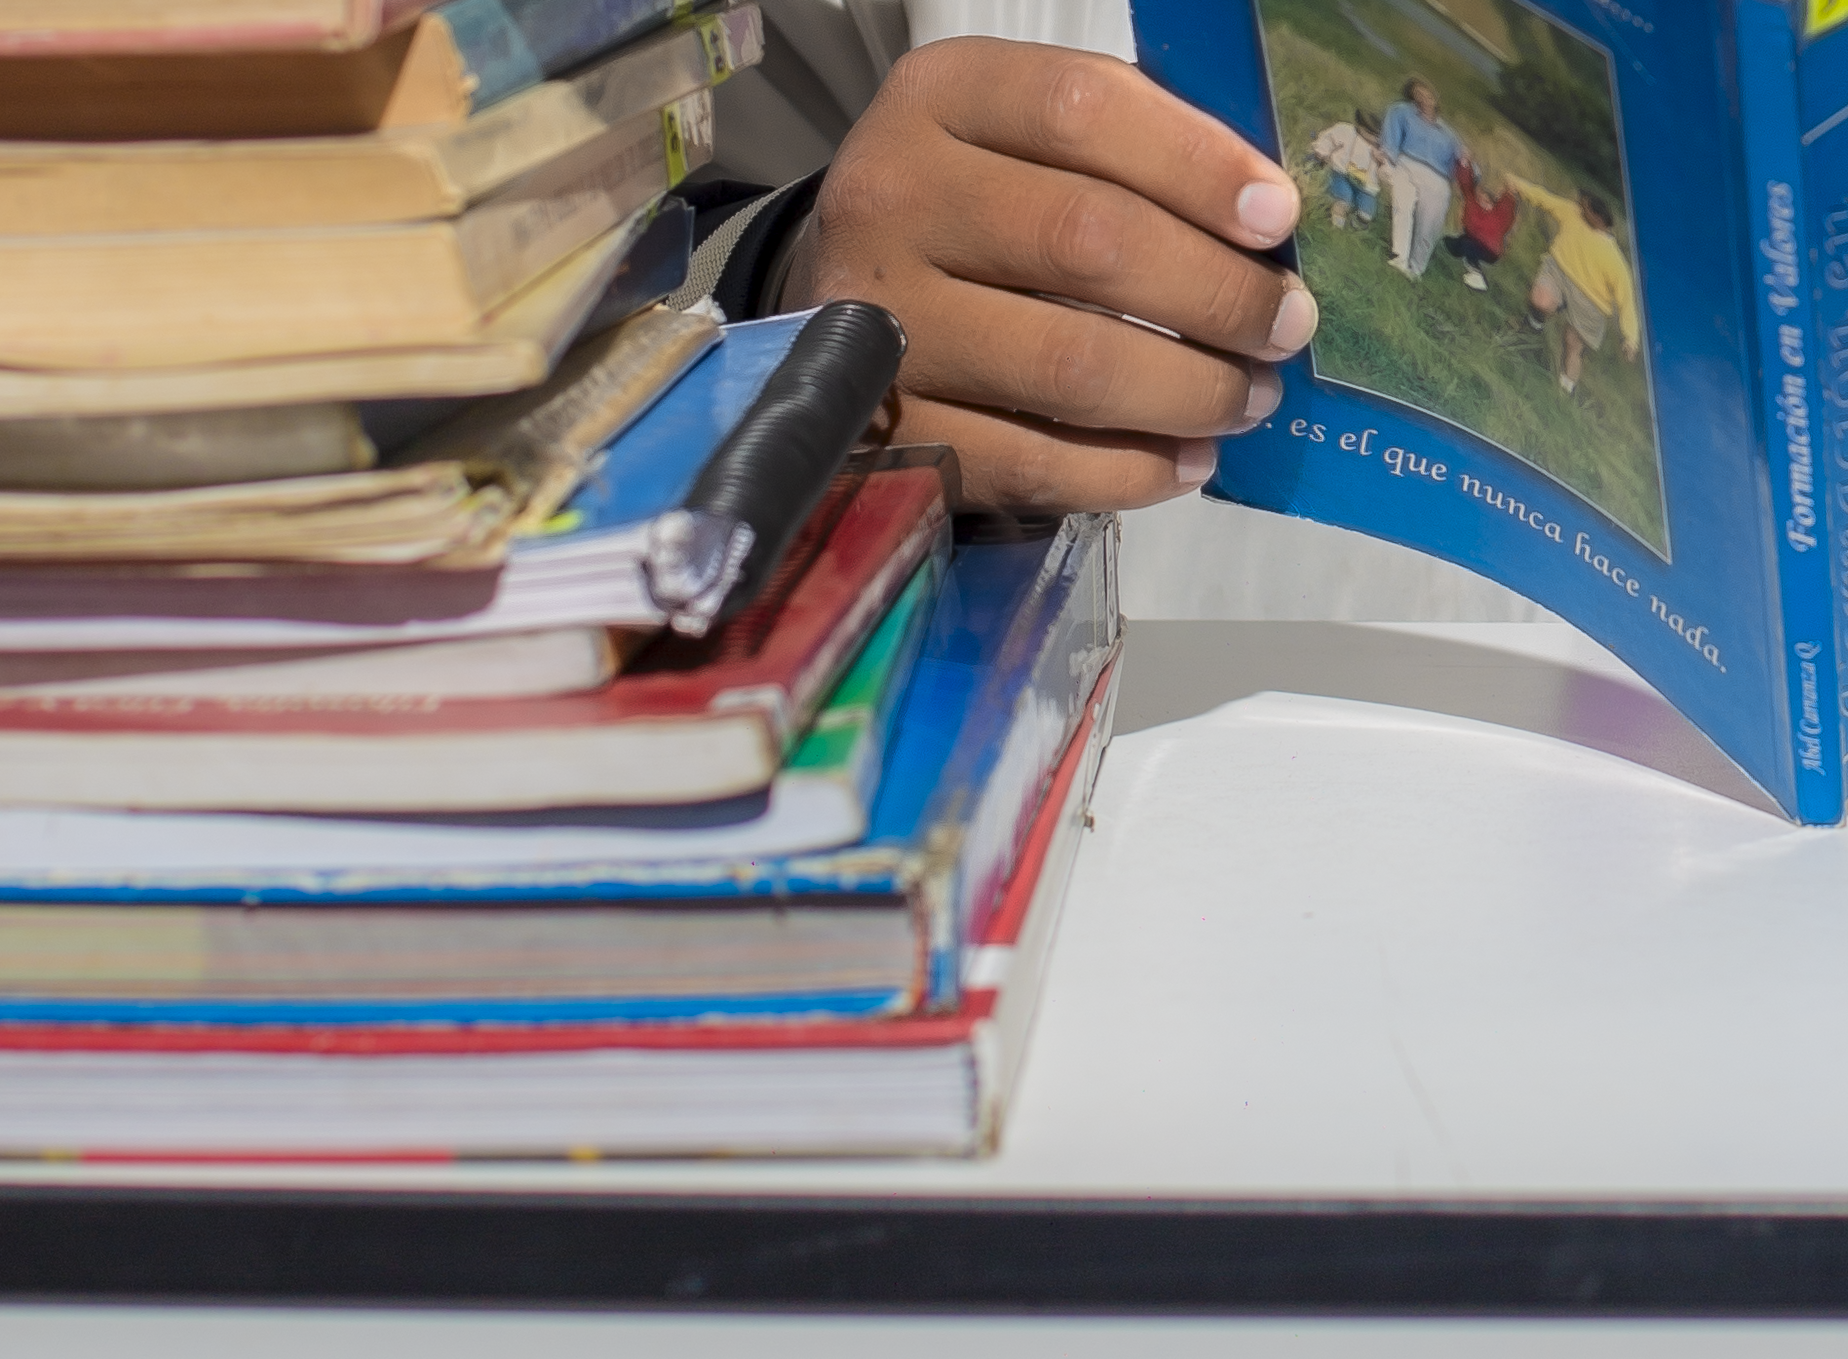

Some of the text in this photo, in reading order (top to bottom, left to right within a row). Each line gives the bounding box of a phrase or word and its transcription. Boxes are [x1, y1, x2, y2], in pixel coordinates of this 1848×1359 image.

[1758, 179, 1818, 553] Formación en Valores
[1338, 427, 1380, 457] el
[1383, 445, 1449, 482] que
[1459, 472, 1564, 544] nunca
[1573, 530, 1642, 599] hace
[1649, 593, 1728, 675] nada.
